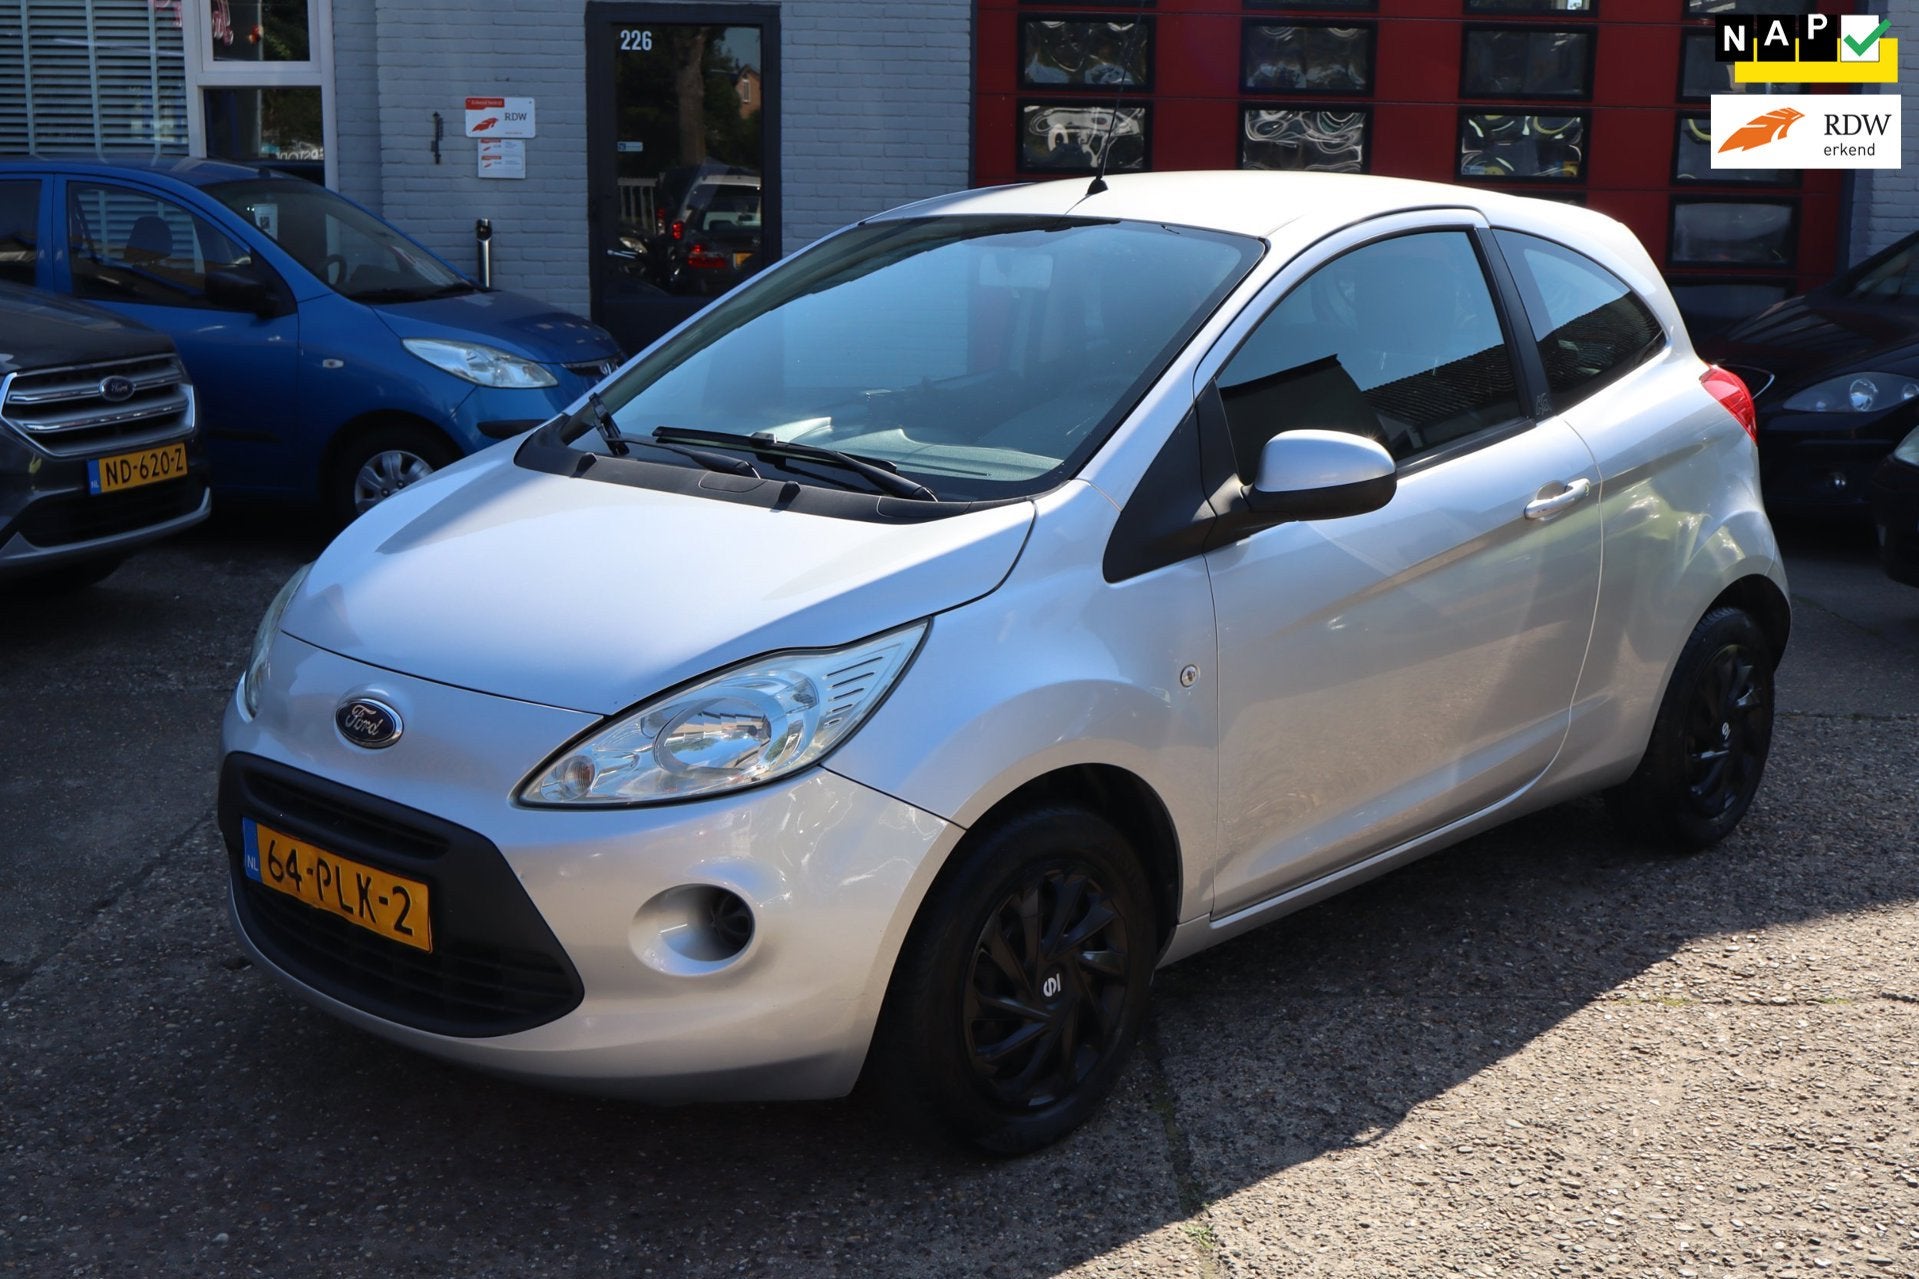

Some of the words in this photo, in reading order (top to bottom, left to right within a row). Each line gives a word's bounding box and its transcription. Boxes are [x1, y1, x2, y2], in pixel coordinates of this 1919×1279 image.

[620, 29, 652, 51] 226
[504, 112, 527, 121] RDW
[104, 448, 184, 487] ND-620-Z
[344, 704, 384, 736] Ford
[247, 856, 259, 872] NL
[267, 839, 414, 936] 64-PLK-2
